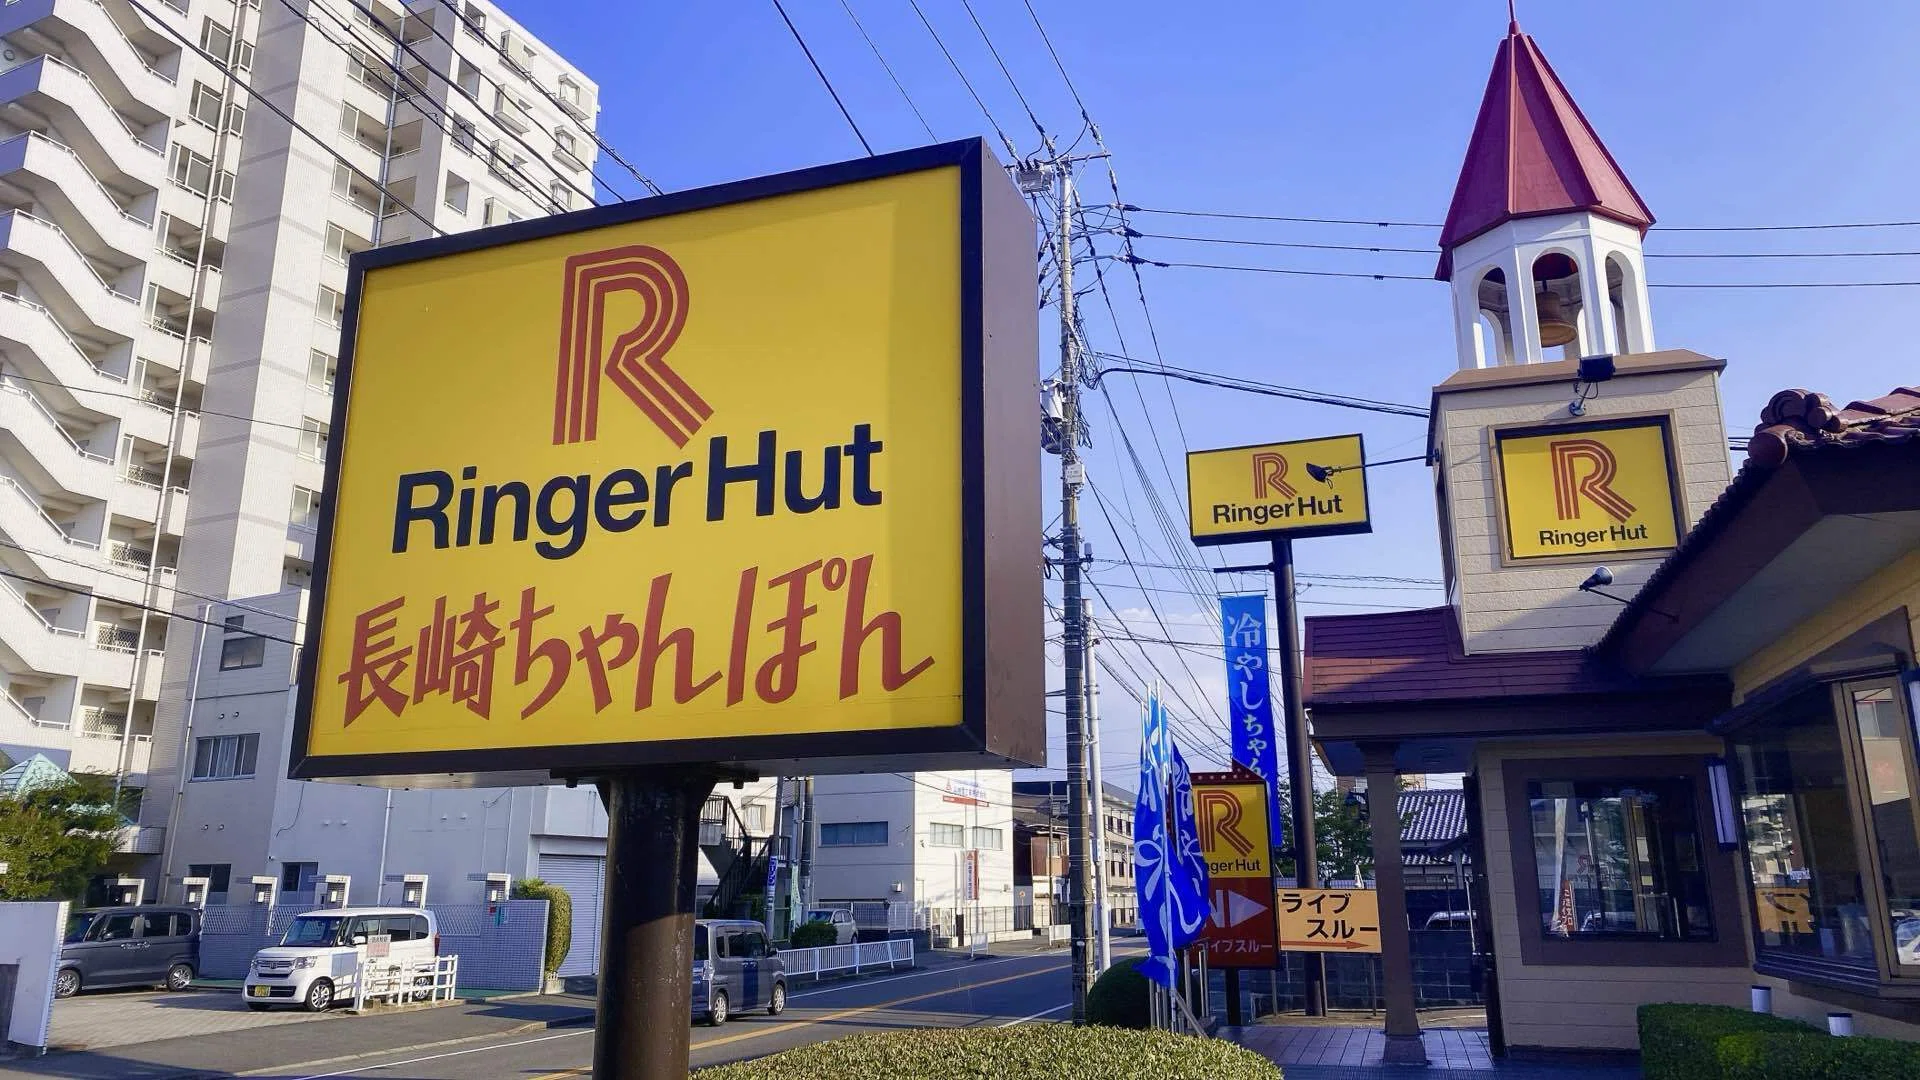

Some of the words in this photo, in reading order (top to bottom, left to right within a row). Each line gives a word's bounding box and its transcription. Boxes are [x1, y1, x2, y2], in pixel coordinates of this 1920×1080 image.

[553, 244, 714, 450] R
[391, 461, 693, 560] Ringer
[706, 423, 884, 522] Hut
[1252, 452, 1297, 499] R
[1551, 438, 1637, 524] R
[1213, 501, 1295, 525] Ringer
[1298, 494, 1343, 517] Hut
[1539, 529, 1607, 547] Ringer
[1610, 524, 1648, 541] Hut
[338, 553, 936, 729] 長崎ちゃんぽん
[1236, 859, 1261, 872] Hut
[1282, 893, 1351, 914] ライブ
[1307, 919, 1378, 939] スルー
